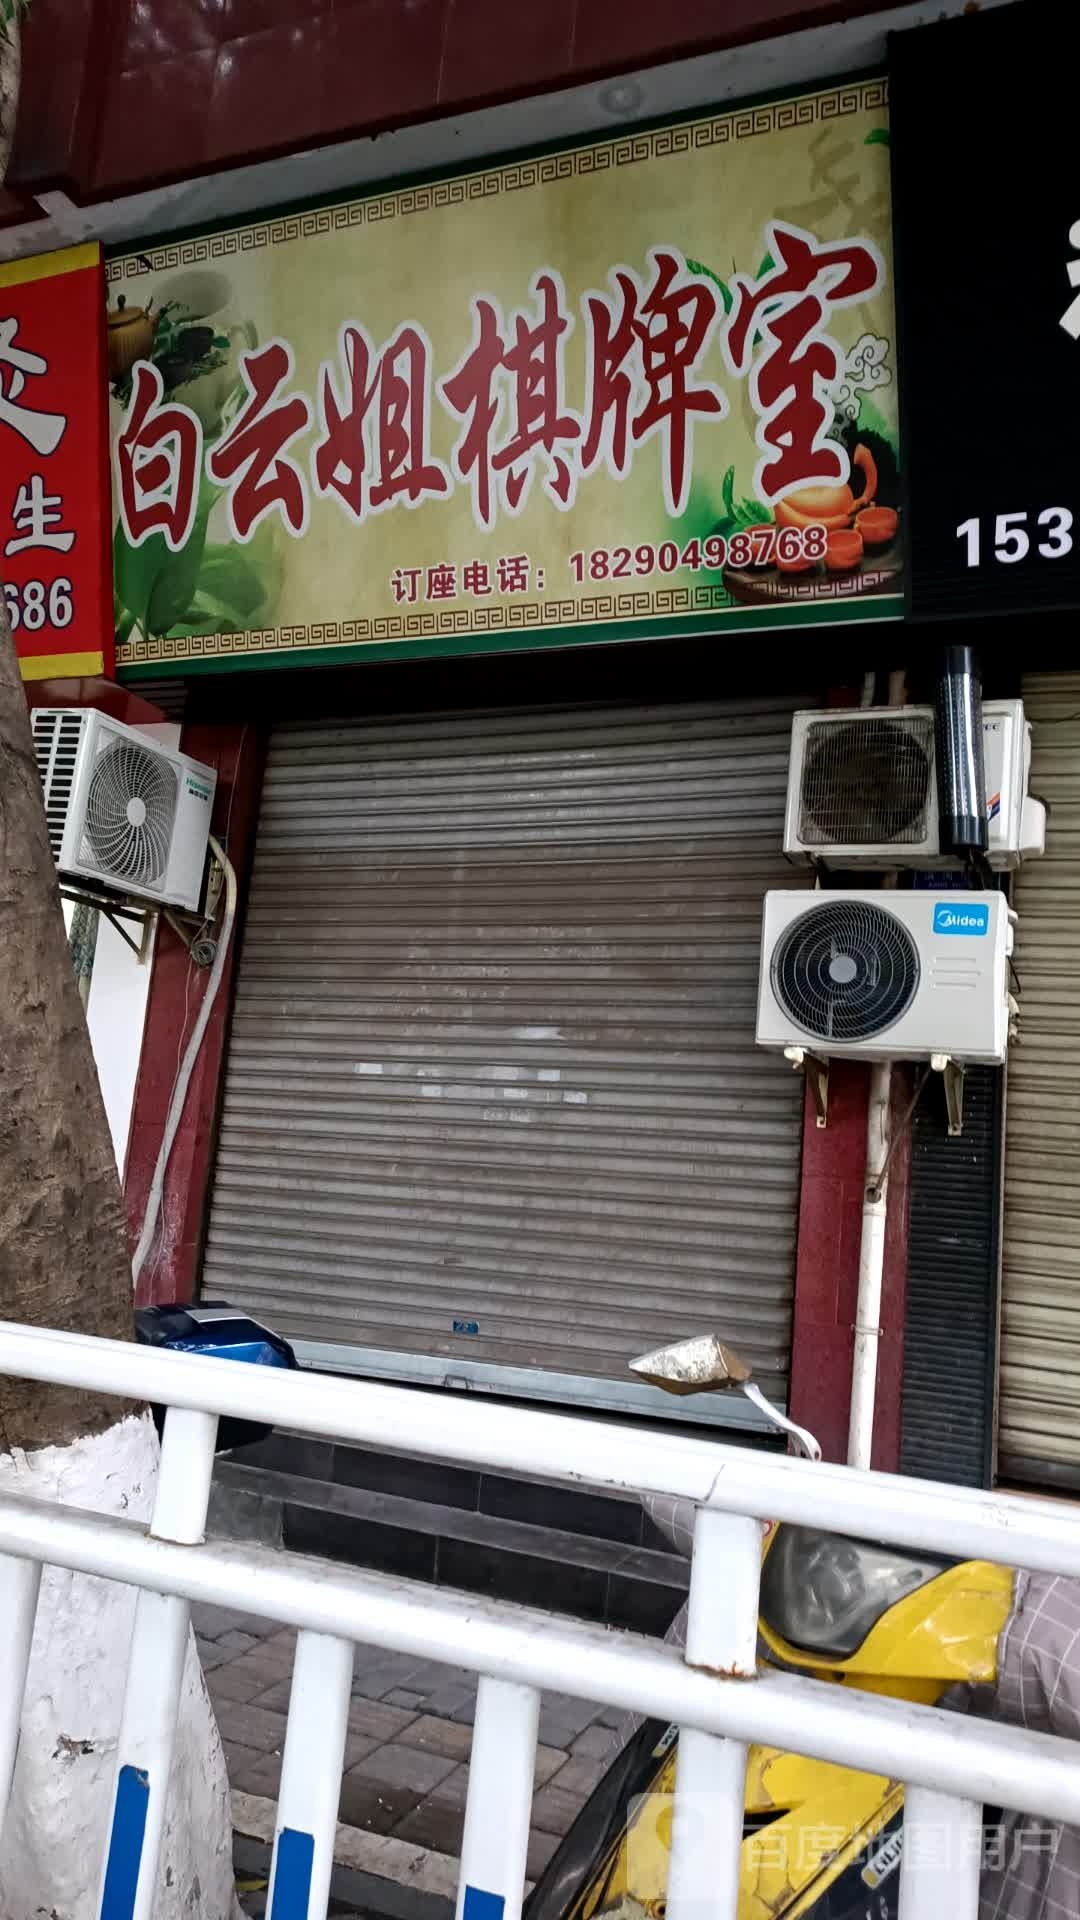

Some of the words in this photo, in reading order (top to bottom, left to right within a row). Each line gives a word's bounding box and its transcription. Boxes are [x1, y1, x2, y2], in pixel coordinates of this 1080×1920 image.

[113, 222, 883, 550] 白云姐棋牌室
[5, 475, 75, 556] 生
[956, 506, 1073, 568] 153
[938, 910, 985, 928] Midea
